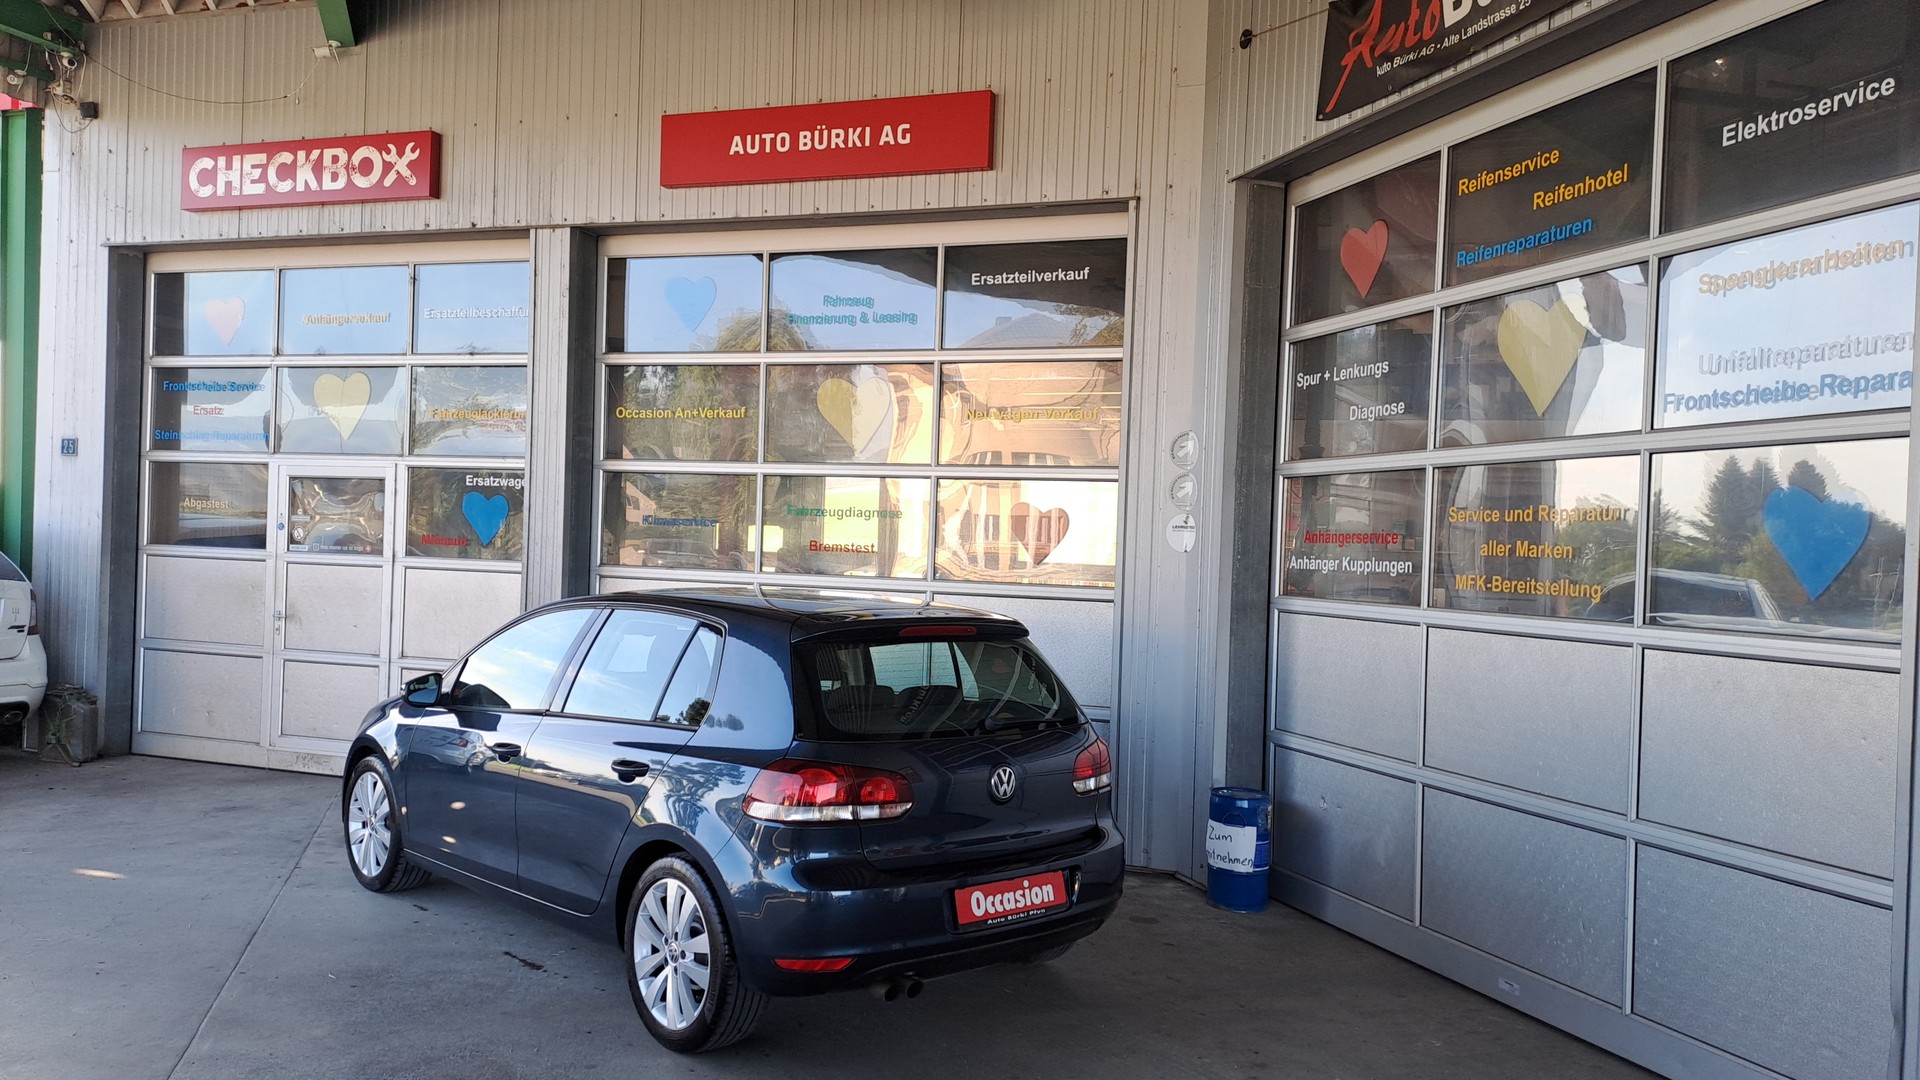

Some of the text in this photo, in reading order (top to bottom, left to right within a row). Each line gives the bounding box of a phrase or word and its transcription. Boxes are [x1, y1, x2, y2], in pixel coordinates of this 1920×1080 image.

[1376, 61, 1392, 78] Auto
[1393, 49, 1419, 68] Bürki
[1418, 43, 1436, 58] AG
[1441, 33, 1460, 49] Alte
[1461, 4, 1517, 40] Landstrasse
[1722, 77, 1896, 147] Elektroservice
[729, 124, 911, 155] AUTO BÜRKI AG
[188, 142, 420, 199] CHECKBOX
[1458, 149, 1560, 196] Reifenservice
[1533, 163, 1629, 210] Reifenhotel
[1456, 218, 1593, 267] Reifenreparaturen
[971, 267, 1090, 286] Ersatzteilverkauf
[1698, 239, 1910, 297] Spenglerarbeiten
[823, 295, 875, 308] Fahrzeug
[860, 311, 869, 323] &
[872, 311, 918, 325] Leasing
[1698, 331, 1914, 376] Unfallreparaturen
[1296, 373, 1321, 389] Spur
[1333, 361, 1389, 381] Lenkungs
[1663, 380, 1810, 414] Frontscheibe
[193, 405, 223, 415] Ersatz
[616, 407, 671, 418] Occasion
[1045, 407, 1099, 419] Verkauf
[1350, 401, 1405, 421] Diagnose
[63, 440, 74, 453] 25
[184, 498, 230, 509] Abgastest
[786, 504, 903, 520] Fahrzeugdiagnose
[1449, 507, 1500, 523] Service
[1504, 505, 1533, 522] und
[809, 540, 876, 553] Bremstest
[1304, 529, 1398, 547] Anhängerservice
[1480, 540, 1573, 559] aller Marken
[1290, 556, 1412, 576] Anhänger Kupplungen
[1455, 574, 1601, 604] MFK-Bereitstellung
[1208, 824, 1233, 843] Zum
[970, 879, 1054, 917] Occasion
[987, 917, 1005, 925] Auto
[1007, 912, 1027, 921] Bürki
